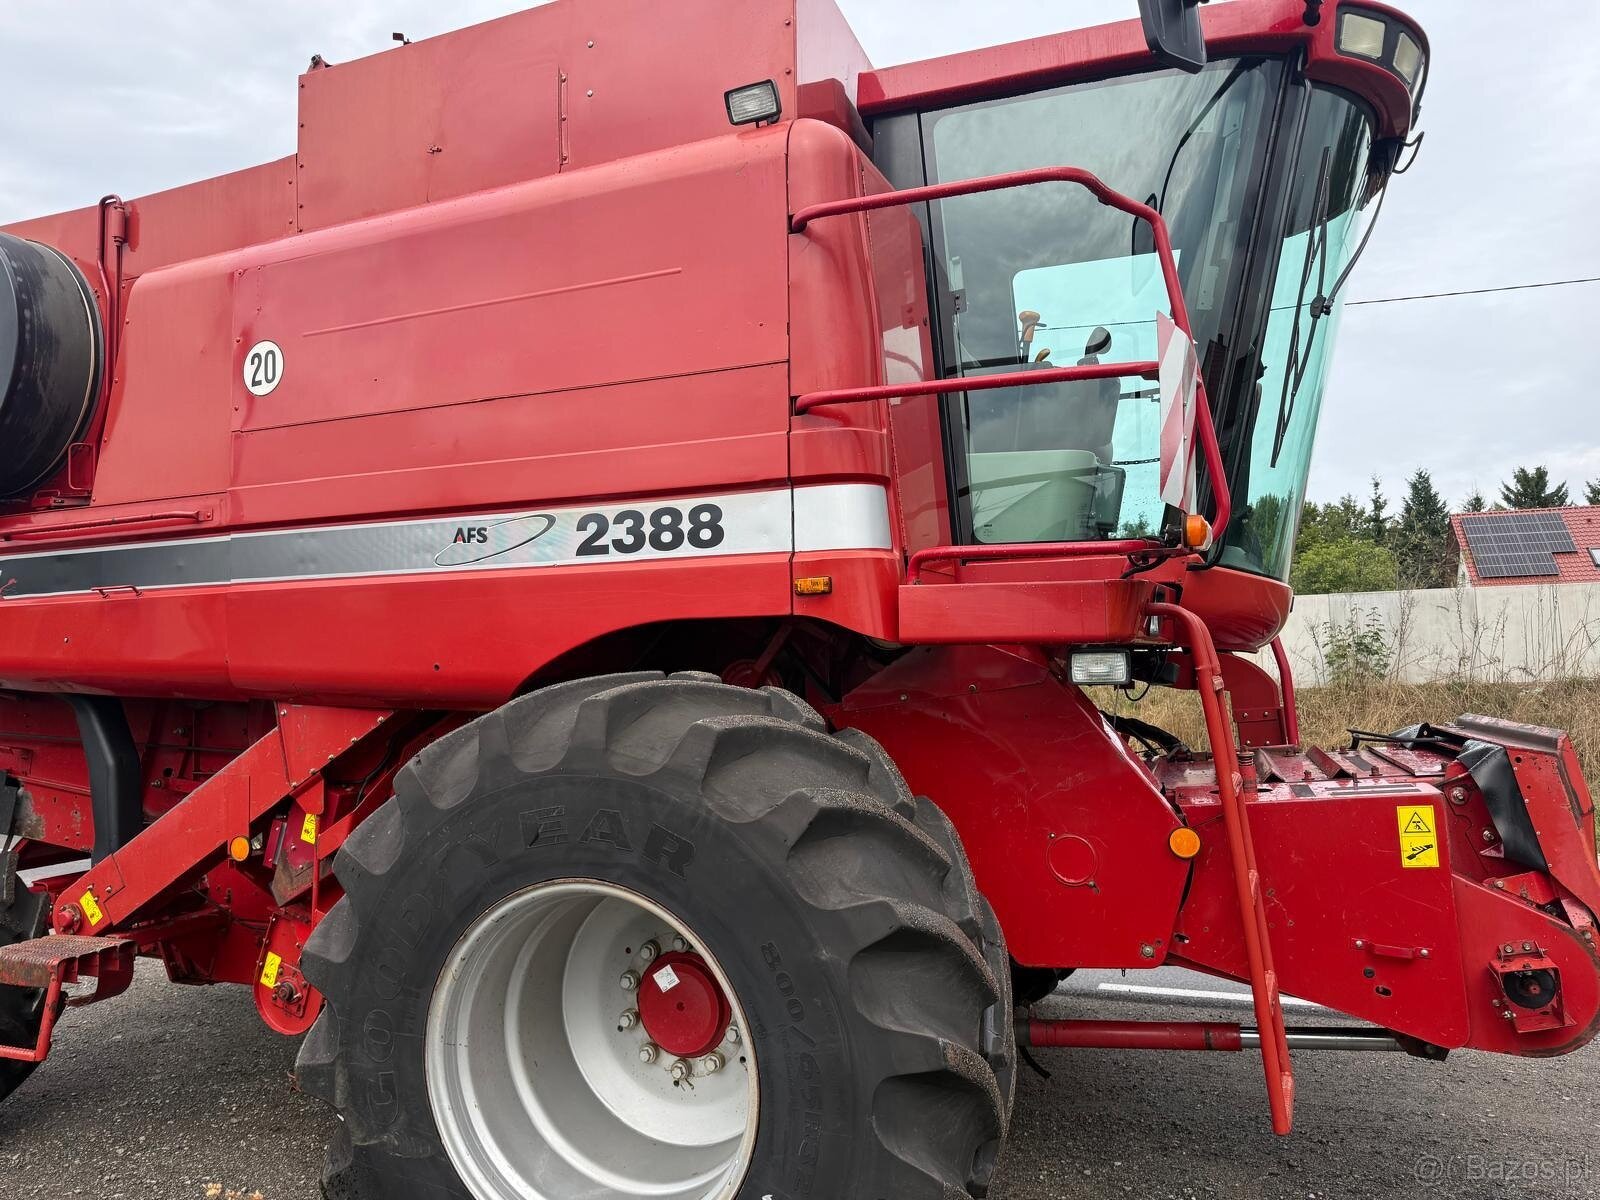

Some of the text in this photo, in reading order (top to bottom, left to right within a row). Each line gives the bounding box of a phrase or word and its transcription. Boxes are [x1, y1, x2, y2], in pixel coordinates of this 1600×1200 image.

[250, 349, 276, 387] 20
[453, 527, 488, 544] AFS
[575, 503, 725, 557] 2388
